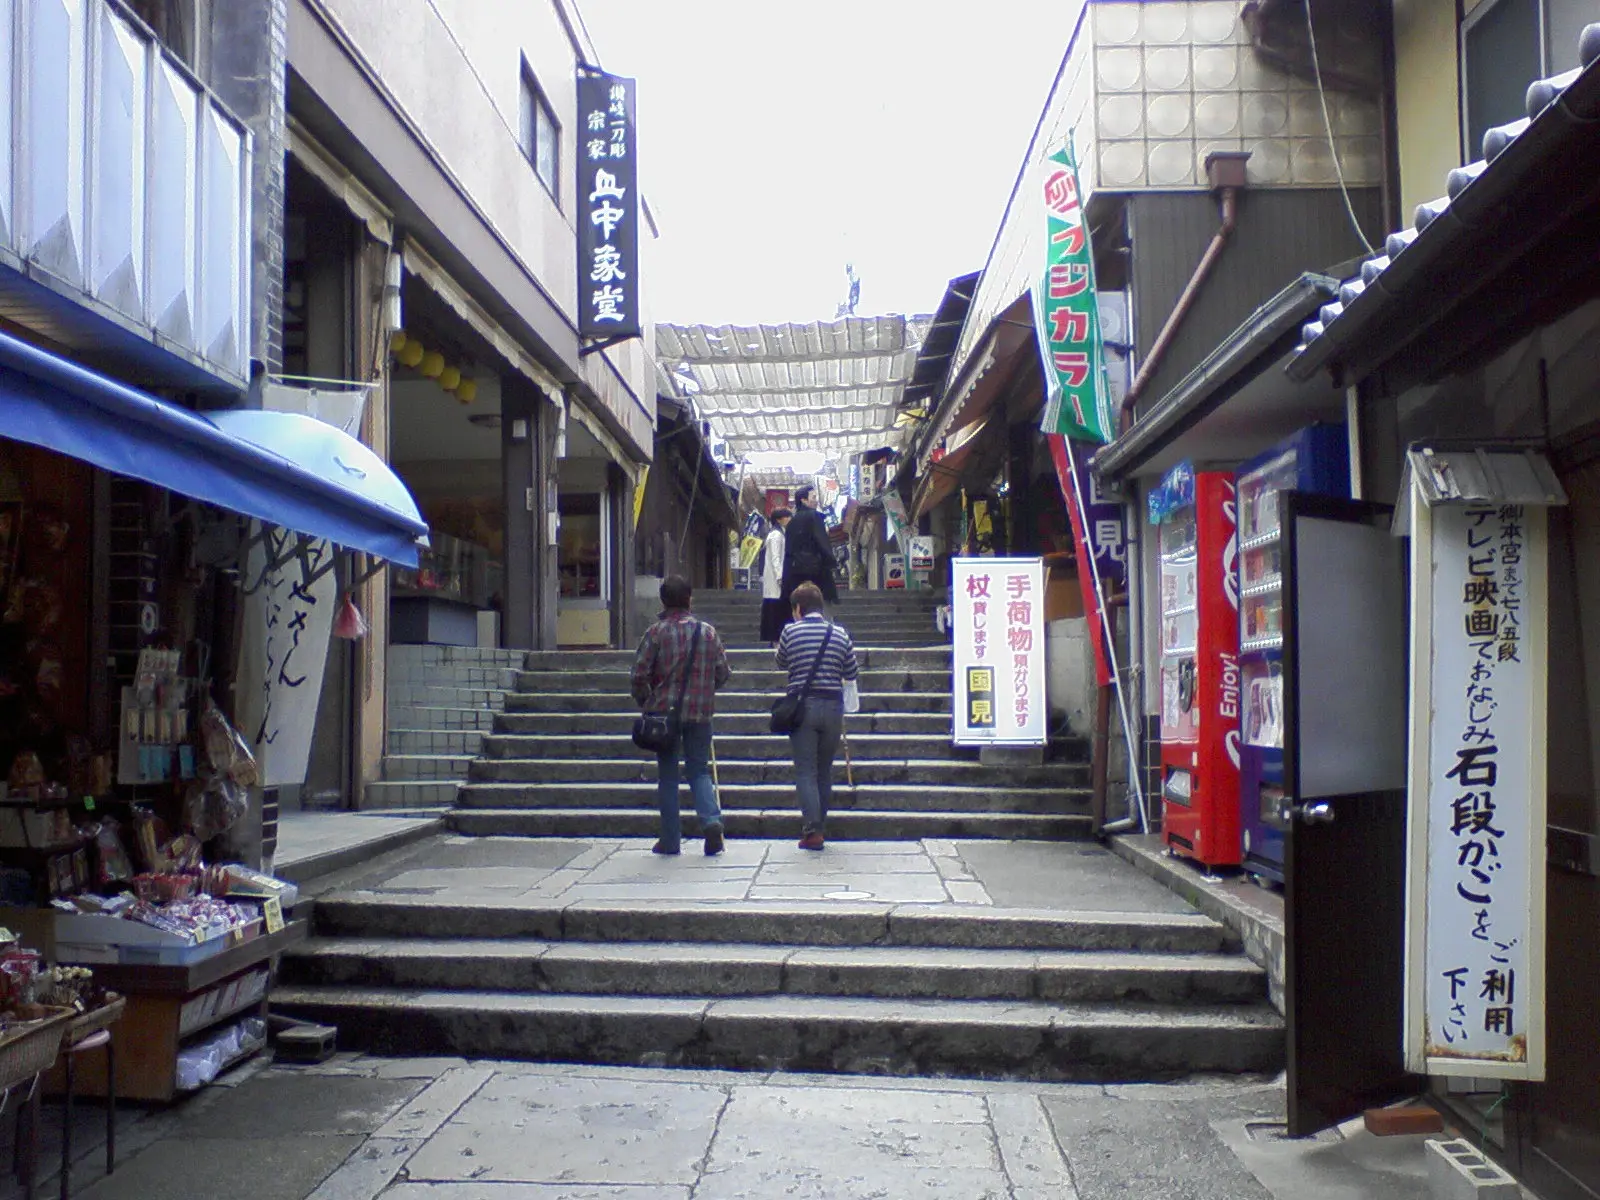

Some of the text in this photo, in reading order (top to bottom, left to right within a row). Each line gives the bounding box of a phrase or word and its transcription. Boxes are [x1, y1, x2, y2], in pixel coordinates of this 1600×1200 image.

[586, 109, 607, 160] 宗家
[1048, 223, 1091, 428] フジカラー
[965, 573, 993, 660] 杖貸します
[1005, 573, 1034, 728] 手荷物預かります
[1219, 652, 1240, 718] Enjoy!
[1442, 966, 1470, 1044] 下さい
[1479, 938, 1518, 1037] ご利用
